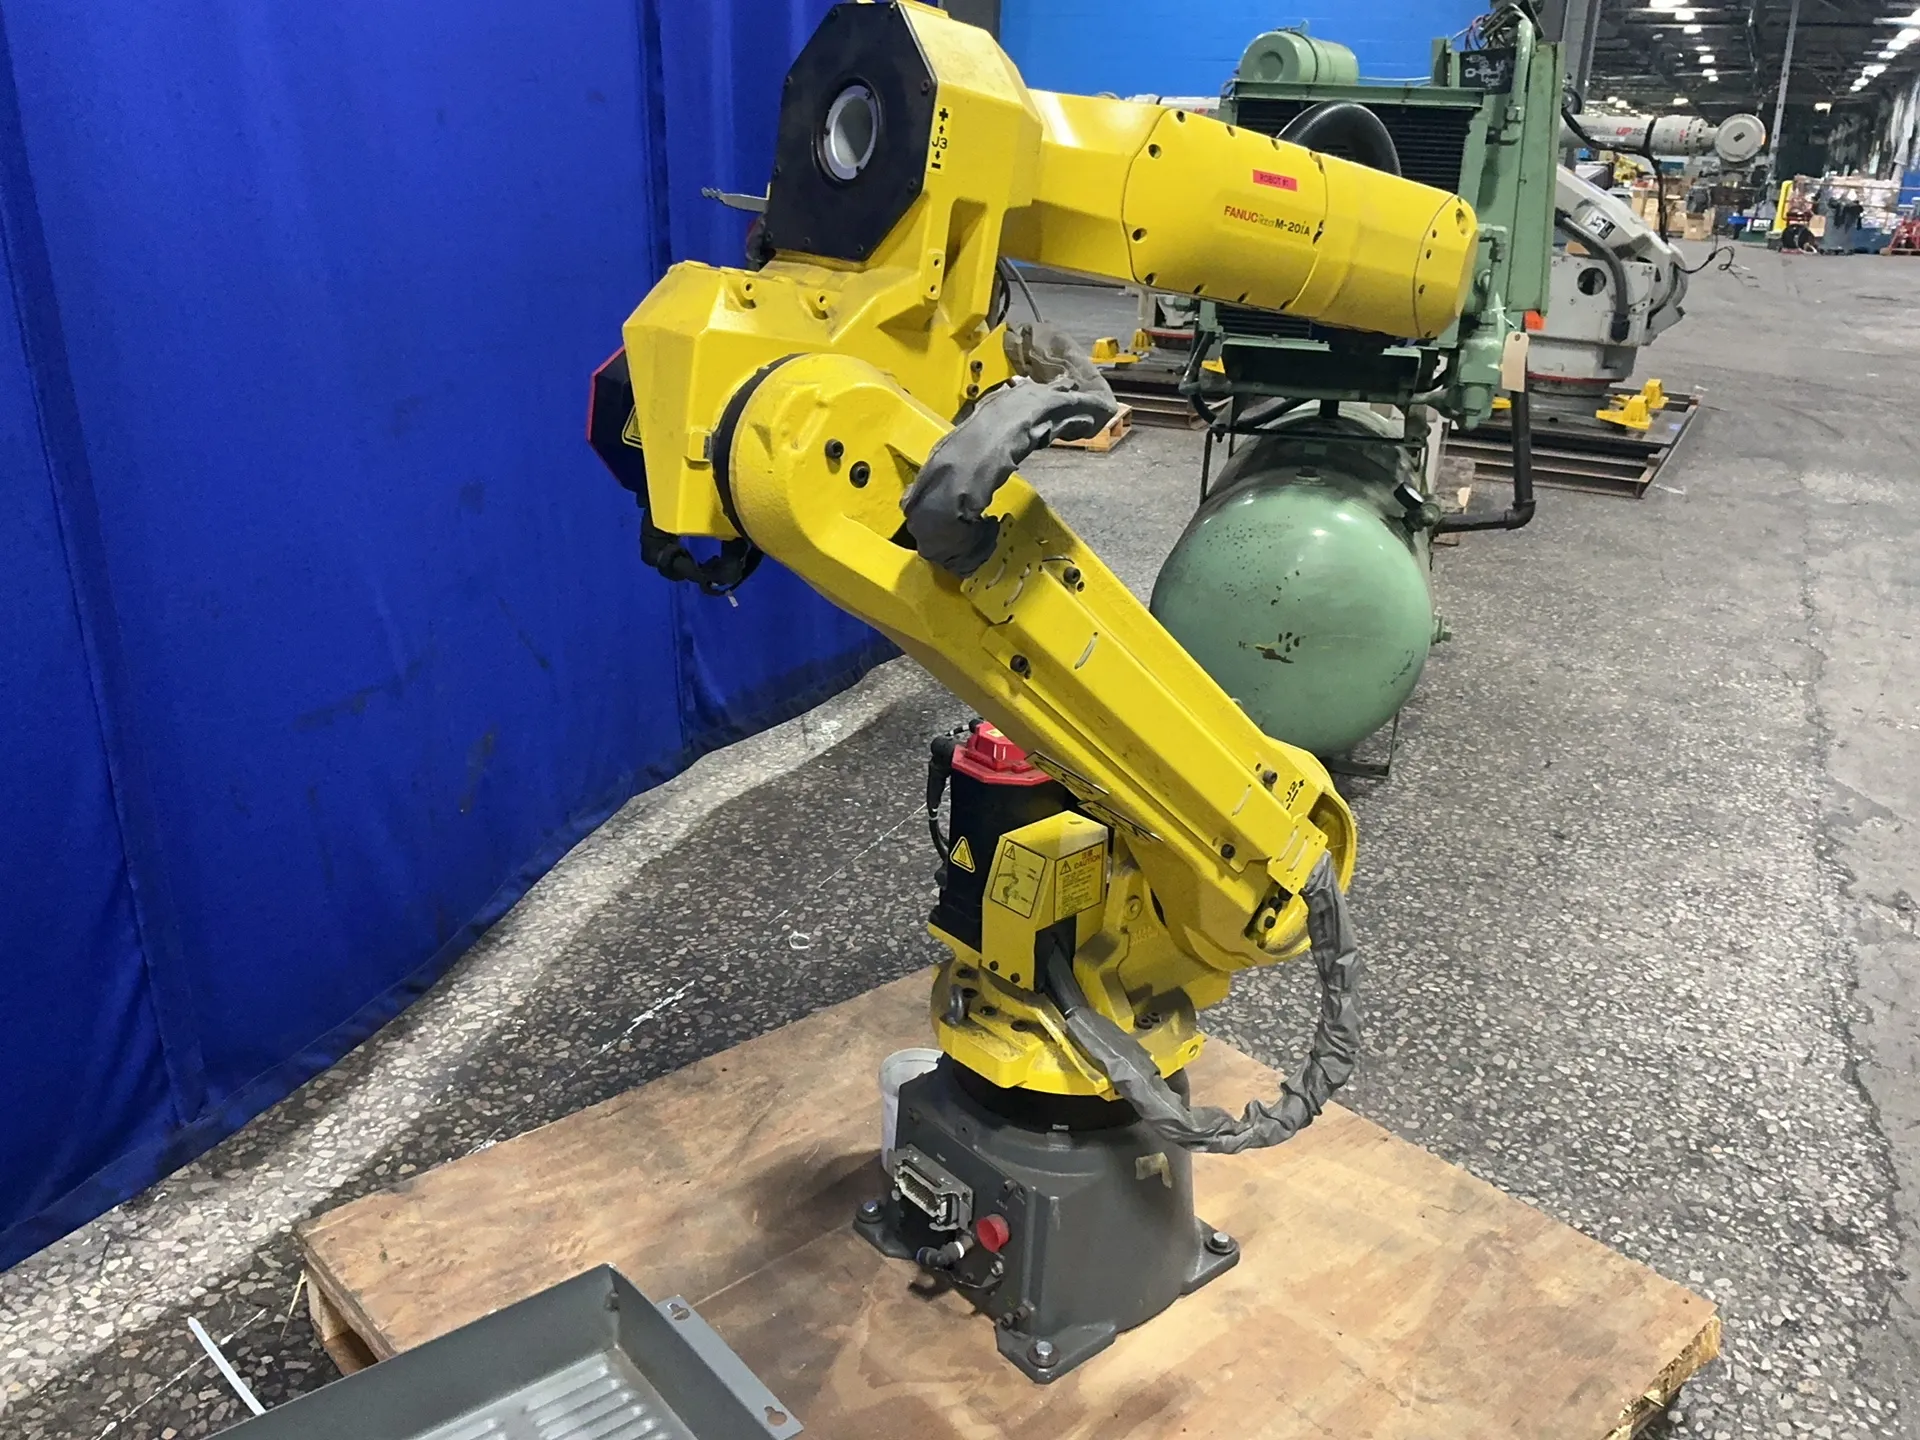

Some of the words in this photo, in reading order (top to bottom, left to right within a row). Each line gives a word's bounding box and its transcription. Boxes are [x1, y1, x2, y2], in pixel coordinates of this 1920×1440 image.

[931, 136, 948, 149] J3
[1224, 205, 1259, 223] FANUC
[1286, 781, 1298, 802] J2
[1074, 854, 1101, 869] CAUTION
